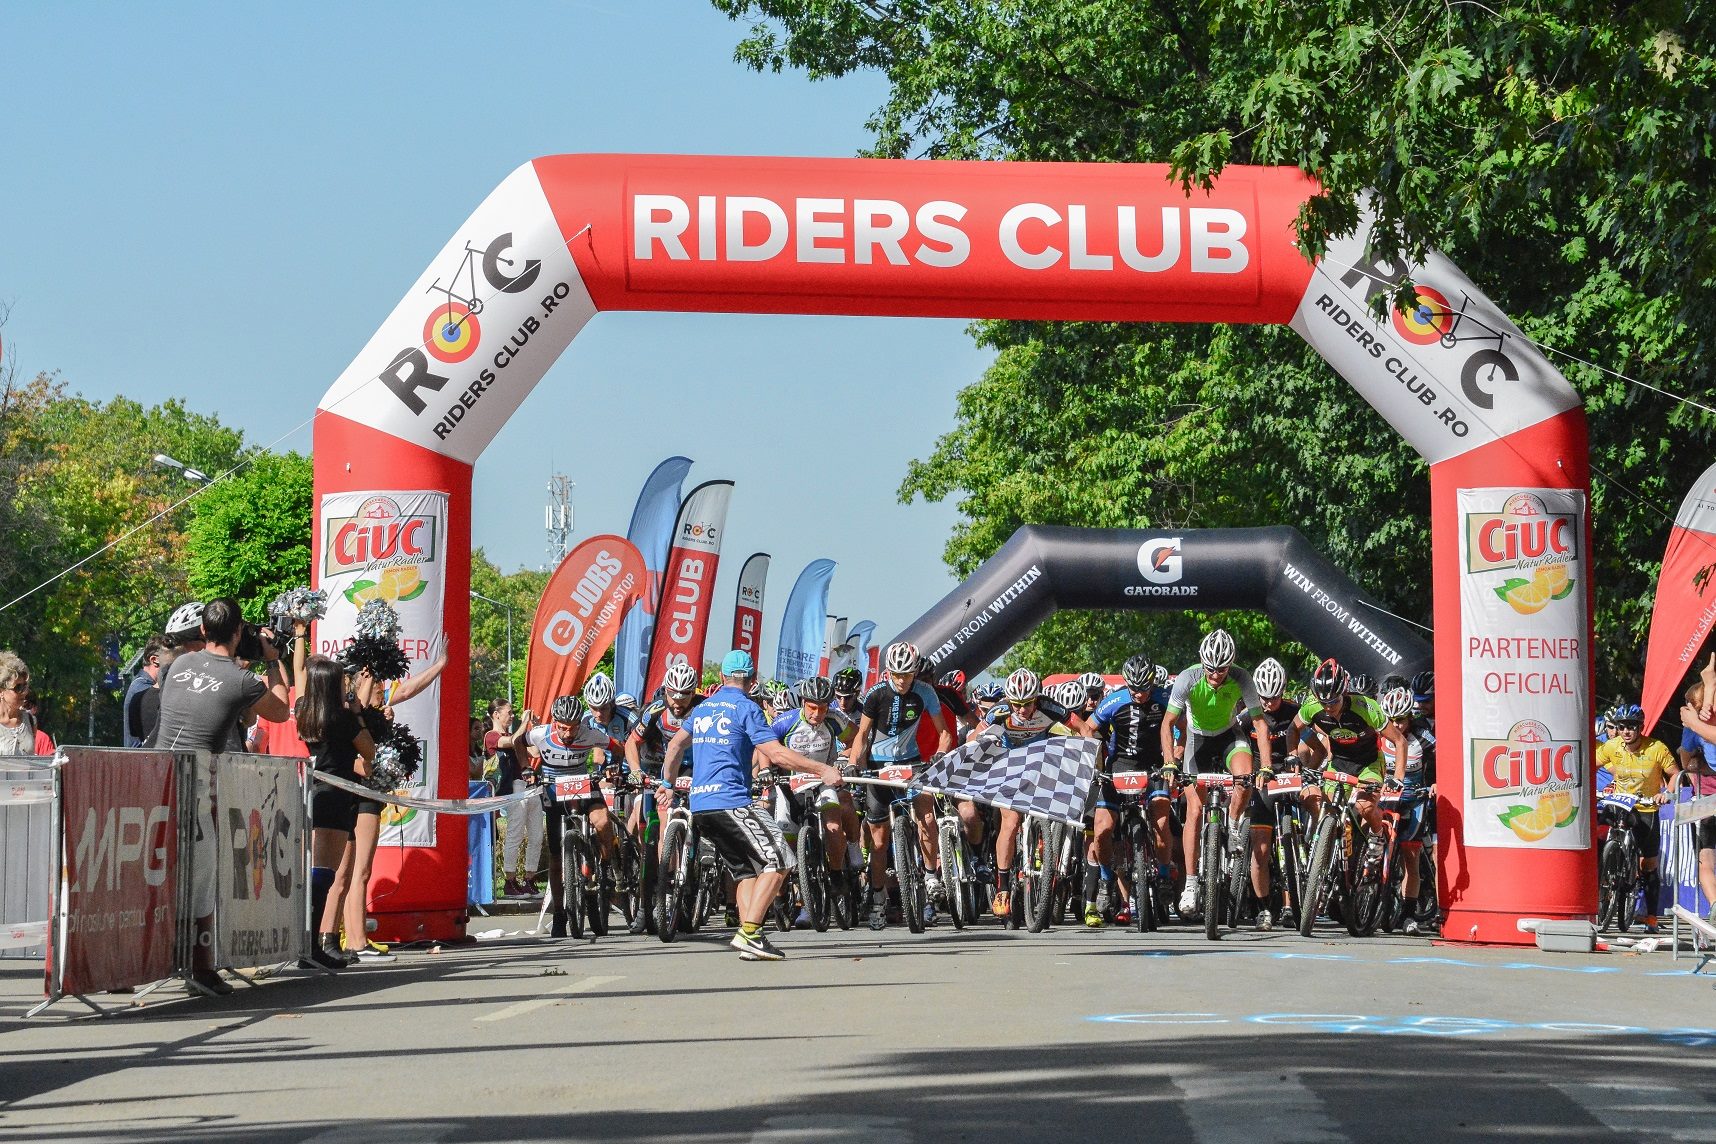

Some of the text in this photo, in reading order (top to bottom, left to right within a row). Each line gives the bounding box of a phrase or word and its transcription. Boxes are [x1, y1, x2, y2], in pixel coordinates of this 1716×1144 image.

[633, 194, 1250, 274] RIDERS CLUB
[432, 282, 570, 441] RIDERS CLUB .RO
[1314, 293, 1469, 438] RIDERS CLUB .RO
[598, 573, 635, 627] NON-STOP
[670, 558, 705, 644] CLUB
[955, 609, 992, 645] FROM
[992, 564, 1043, 616] WITHIN
[1124, 585, 1198, 596] GATORADE
[1282, 563, 1403, 665] WIN FROM WITHIN
[1469, 637, 1580, 659] PARTENER
[1484, 672, 1574, 694] OFICIAL
[888, 770, 902, 778] 2A
[1124, 777, 1138, 785] 7A
[70, 806, 170, 893] MPG
